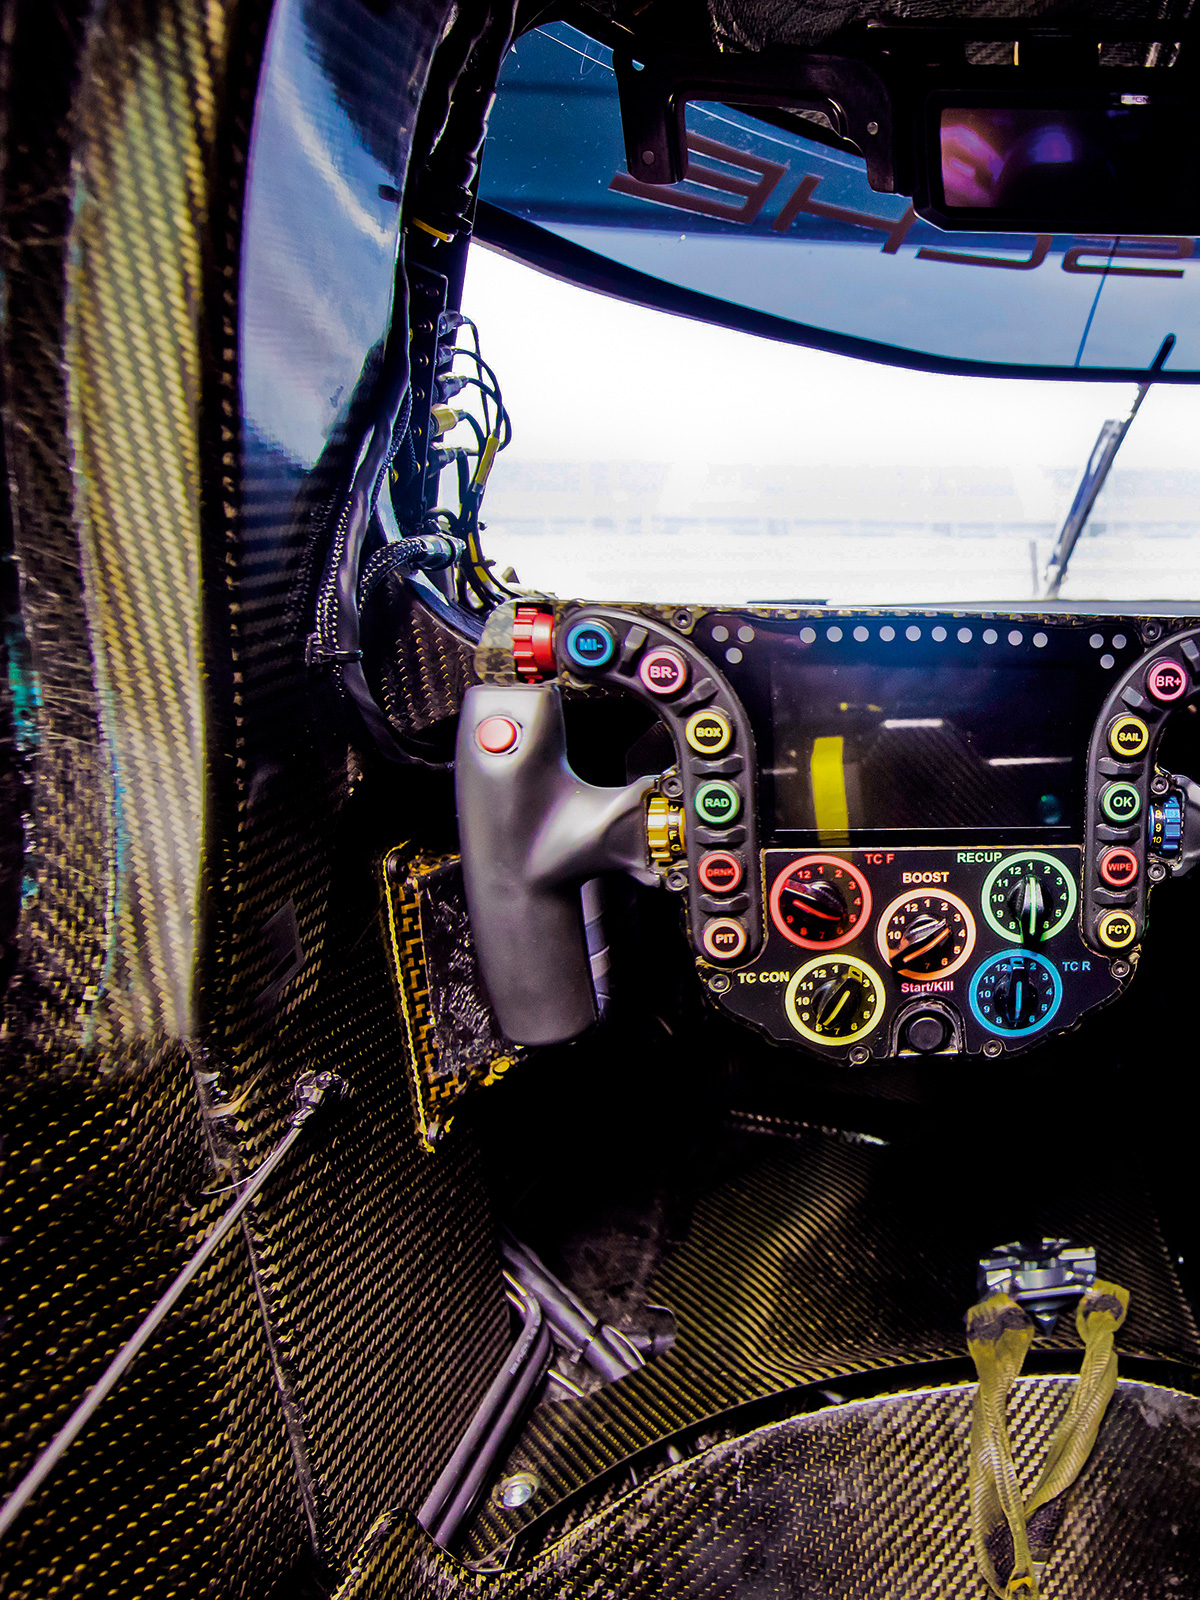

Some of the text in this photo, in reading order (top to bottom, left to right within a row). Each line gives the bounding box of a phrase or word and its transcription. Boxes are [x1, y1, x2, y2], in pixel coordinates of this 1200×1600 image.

[650, 666, 677, 679] BR-
[1156, 675, 1182, 687] BR+
[696, 727, 721, 737] BOX
[1119, 732, 1141, 742] SAIL
[705, 798, 729, 808] RAD
[1113, 796, 1132, 808] OK
[1155, 809, 1162, 818] 8
[1155, 822, 1162, 832] 9
[669, 830, 677, 840] F
[864, 853, 895, 865] TC F
[956, 851, 1003, 864] RECUP
[817, 865, 824, 875] 1
[1008, 866, 1022, 875] 12
[1027, 862, 1033, 871] 1
[1043, 865, 1051, 874] 2
[1108, 862, 1132, 872] WIPE
[707, 868, 735, 877] DRNK
[797, 870, 811, 879] 12
[835, 869, 843, 879] 2
[902, 871, 950, 884] BOOST
[1056, 877, 1063, 885] 3
[848, 881, 857, 890] 3
[996, 878, 1009, 888] 11
[991, 894, 1005, 902] 10
[1060, 892, 1067, 901] 4
[853, 897, 861, 906] 4
[924, 899, 931, 908] 1
[904, 903, 919, 913] 12
[941, 902, 949, 911] 2
[953, 913, 961, 922] 3
[996, 909, 1004, 918] 9
[1055, 909, 1062, 918] 5
[786, 915, 794, 924] 9
[848, 914, 857, 923] 5
[892, 916, 905, 925] 11
[1008, 921, 1016, 930] 8
[1043, 920, 1050, 929] 6
[800, 927, 807, 936] 8
[958, 929, 966, 937] 4
[1108, 925, 1130, 935] FCY
[715, 934, 735, 944] PIT
[887, 931, 902, 940] 10
[953, 946, 961, 955] 5
[941, 957, 948, 966] 6
[1030, 962, 1037, 970] 2
[1062, 960, 1091, 972] TC R
[832, 965, 839, 974] 1
[995, 963, 1008, 972] 12
[737, 971, 790, 984] TC CON
[812, 969, 827, 978] 12
[1042, 973, 1049, 981] 3
[862, 979, 870, 988] 3
[983, 975, 996, 984] 11
[800, 981, 813, 991] 11
[901, 980, 954, 993] Start/Kill
[978, 990, 992, 998] 10
[1045, 987, 1053, 996] 4
[796, 996, 810, 1006] 10
[867, 994, 875, 1003] 4
[983, 1005, 991, 1014] 9
[1041, 1003, 1048, 1012] 5
[801, 1012, 810, 1021] 9
[863, 1011, 870, 1019] 5
[1028, 1015, 1036, 1023] 6
[995, 1016, 1003, 1024] 8
[815, 1023, 823, 1032] 8
[850, 1022, 858, 1031] 6
